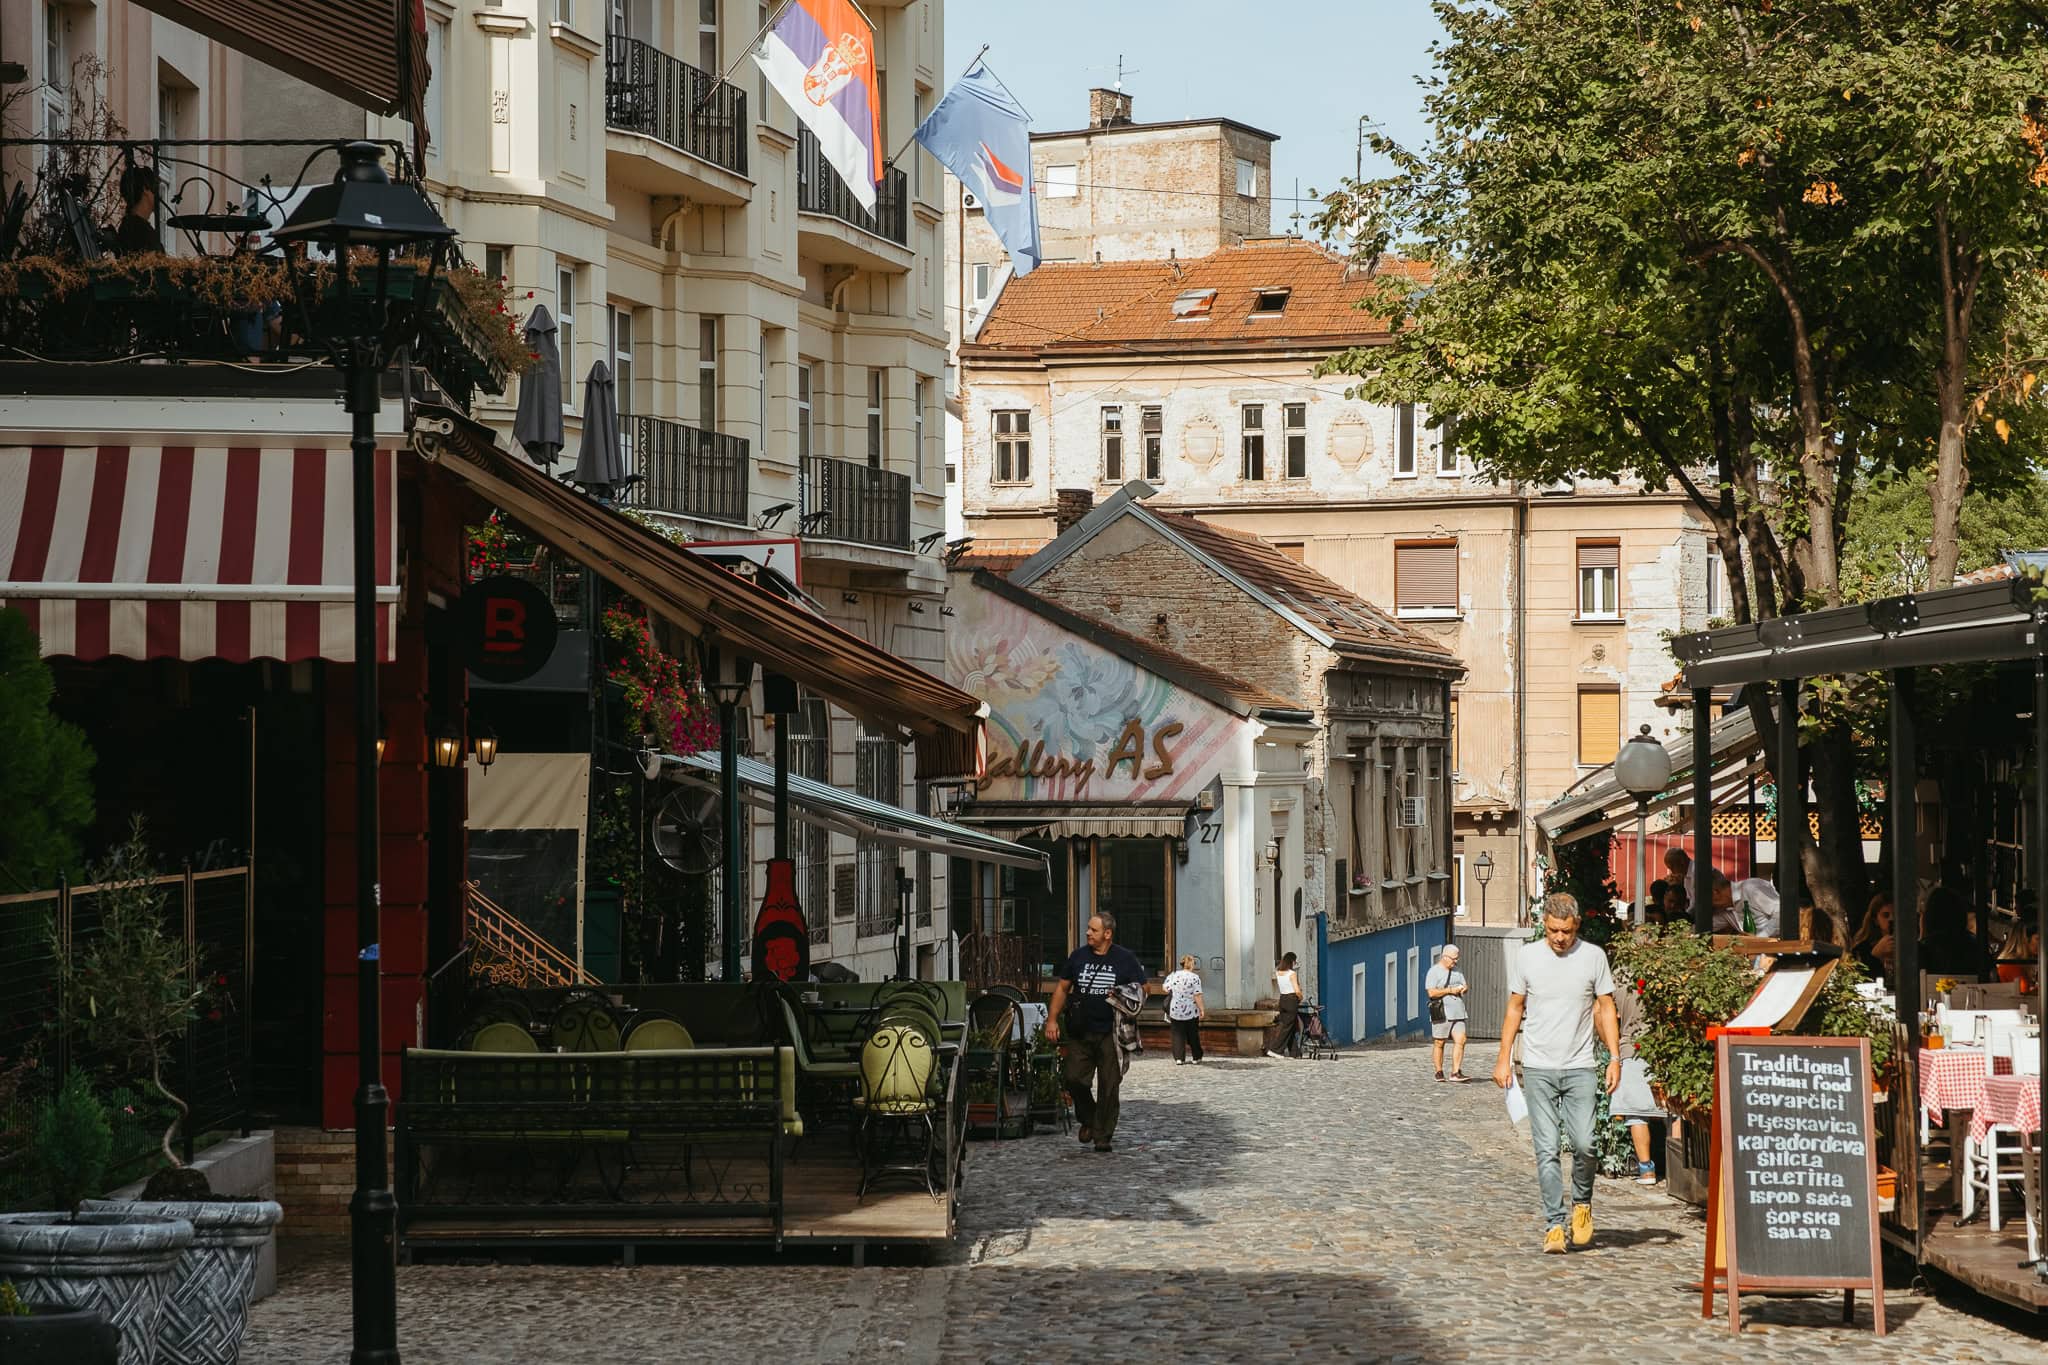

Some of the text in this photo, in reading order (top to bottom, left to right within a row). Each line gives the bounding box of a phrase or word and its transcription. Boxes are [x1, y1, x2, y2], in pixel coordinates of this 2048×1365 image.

[1105, 717, 1184, 781] AS
[1200, 823, 1222, 844] 27
[1736, 1052, 1854, 1077] Traditional
[1741, 1072, 1852, 1092] serbian food
